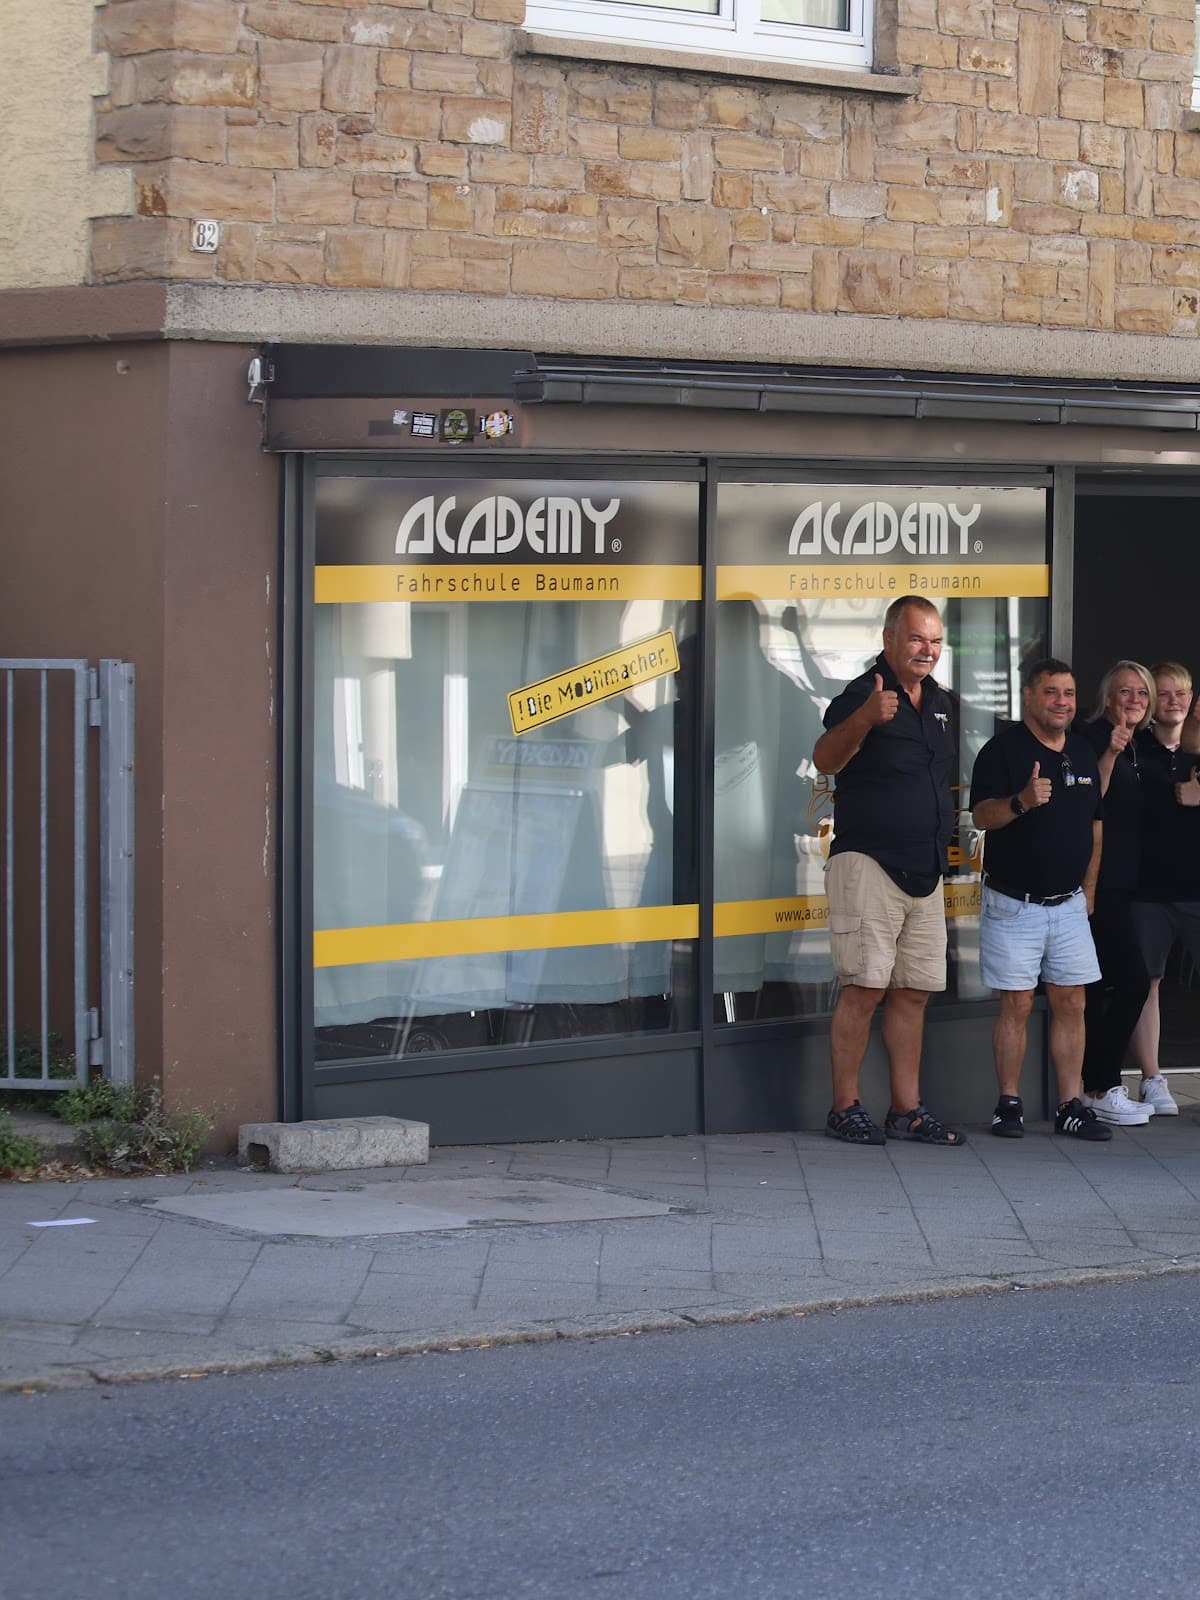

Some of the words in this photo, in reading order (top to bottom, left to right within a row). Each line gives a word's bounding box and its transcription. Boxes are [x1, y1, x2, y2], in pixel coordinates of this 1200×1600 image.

[196, 223, 217, 248] 82
[396, 573, 521, 593] Fahrschule
[535, 573, 619, 592] Baumann
[789, 572, 897, 591] Fahrschule
[909, 573, 981, 590] Baumann
